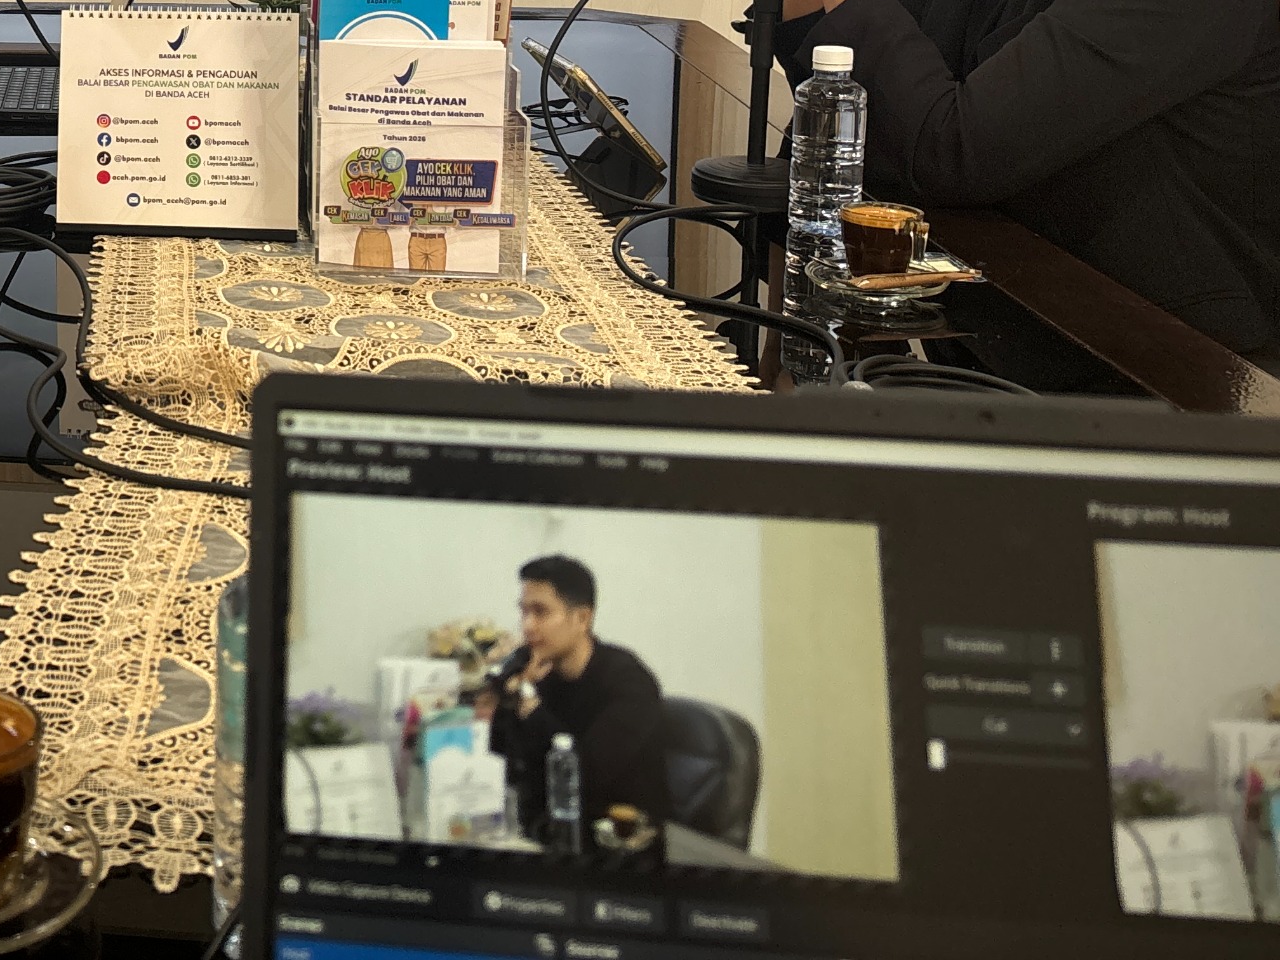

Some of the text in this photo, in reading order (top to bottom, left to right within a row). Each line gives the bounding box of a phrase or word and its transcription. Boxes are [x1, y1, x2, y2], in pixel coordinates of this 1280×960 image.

[132, 69, 184, 78] INFORMASI
[187, 70, 193, 78] &
[196, 70, 257, 79] PENGADUAN
[103, 79, 129, 87] BESAR
[132, 80, 189, 88] PENGAWASAN
[345, 93, 466, 106] STANDAR PELAYANAN
[371, 108, 409, 116] Pengawas
[358, 147, 379, 158] Ayo
[417, 163, 434, 174] AYO
[435, 163, 452, 174] CEK
[416, 176, 472, 186] PILIH OBAT DAN
[404, 187, 486, 198] MAKANAN YANG AMAN
